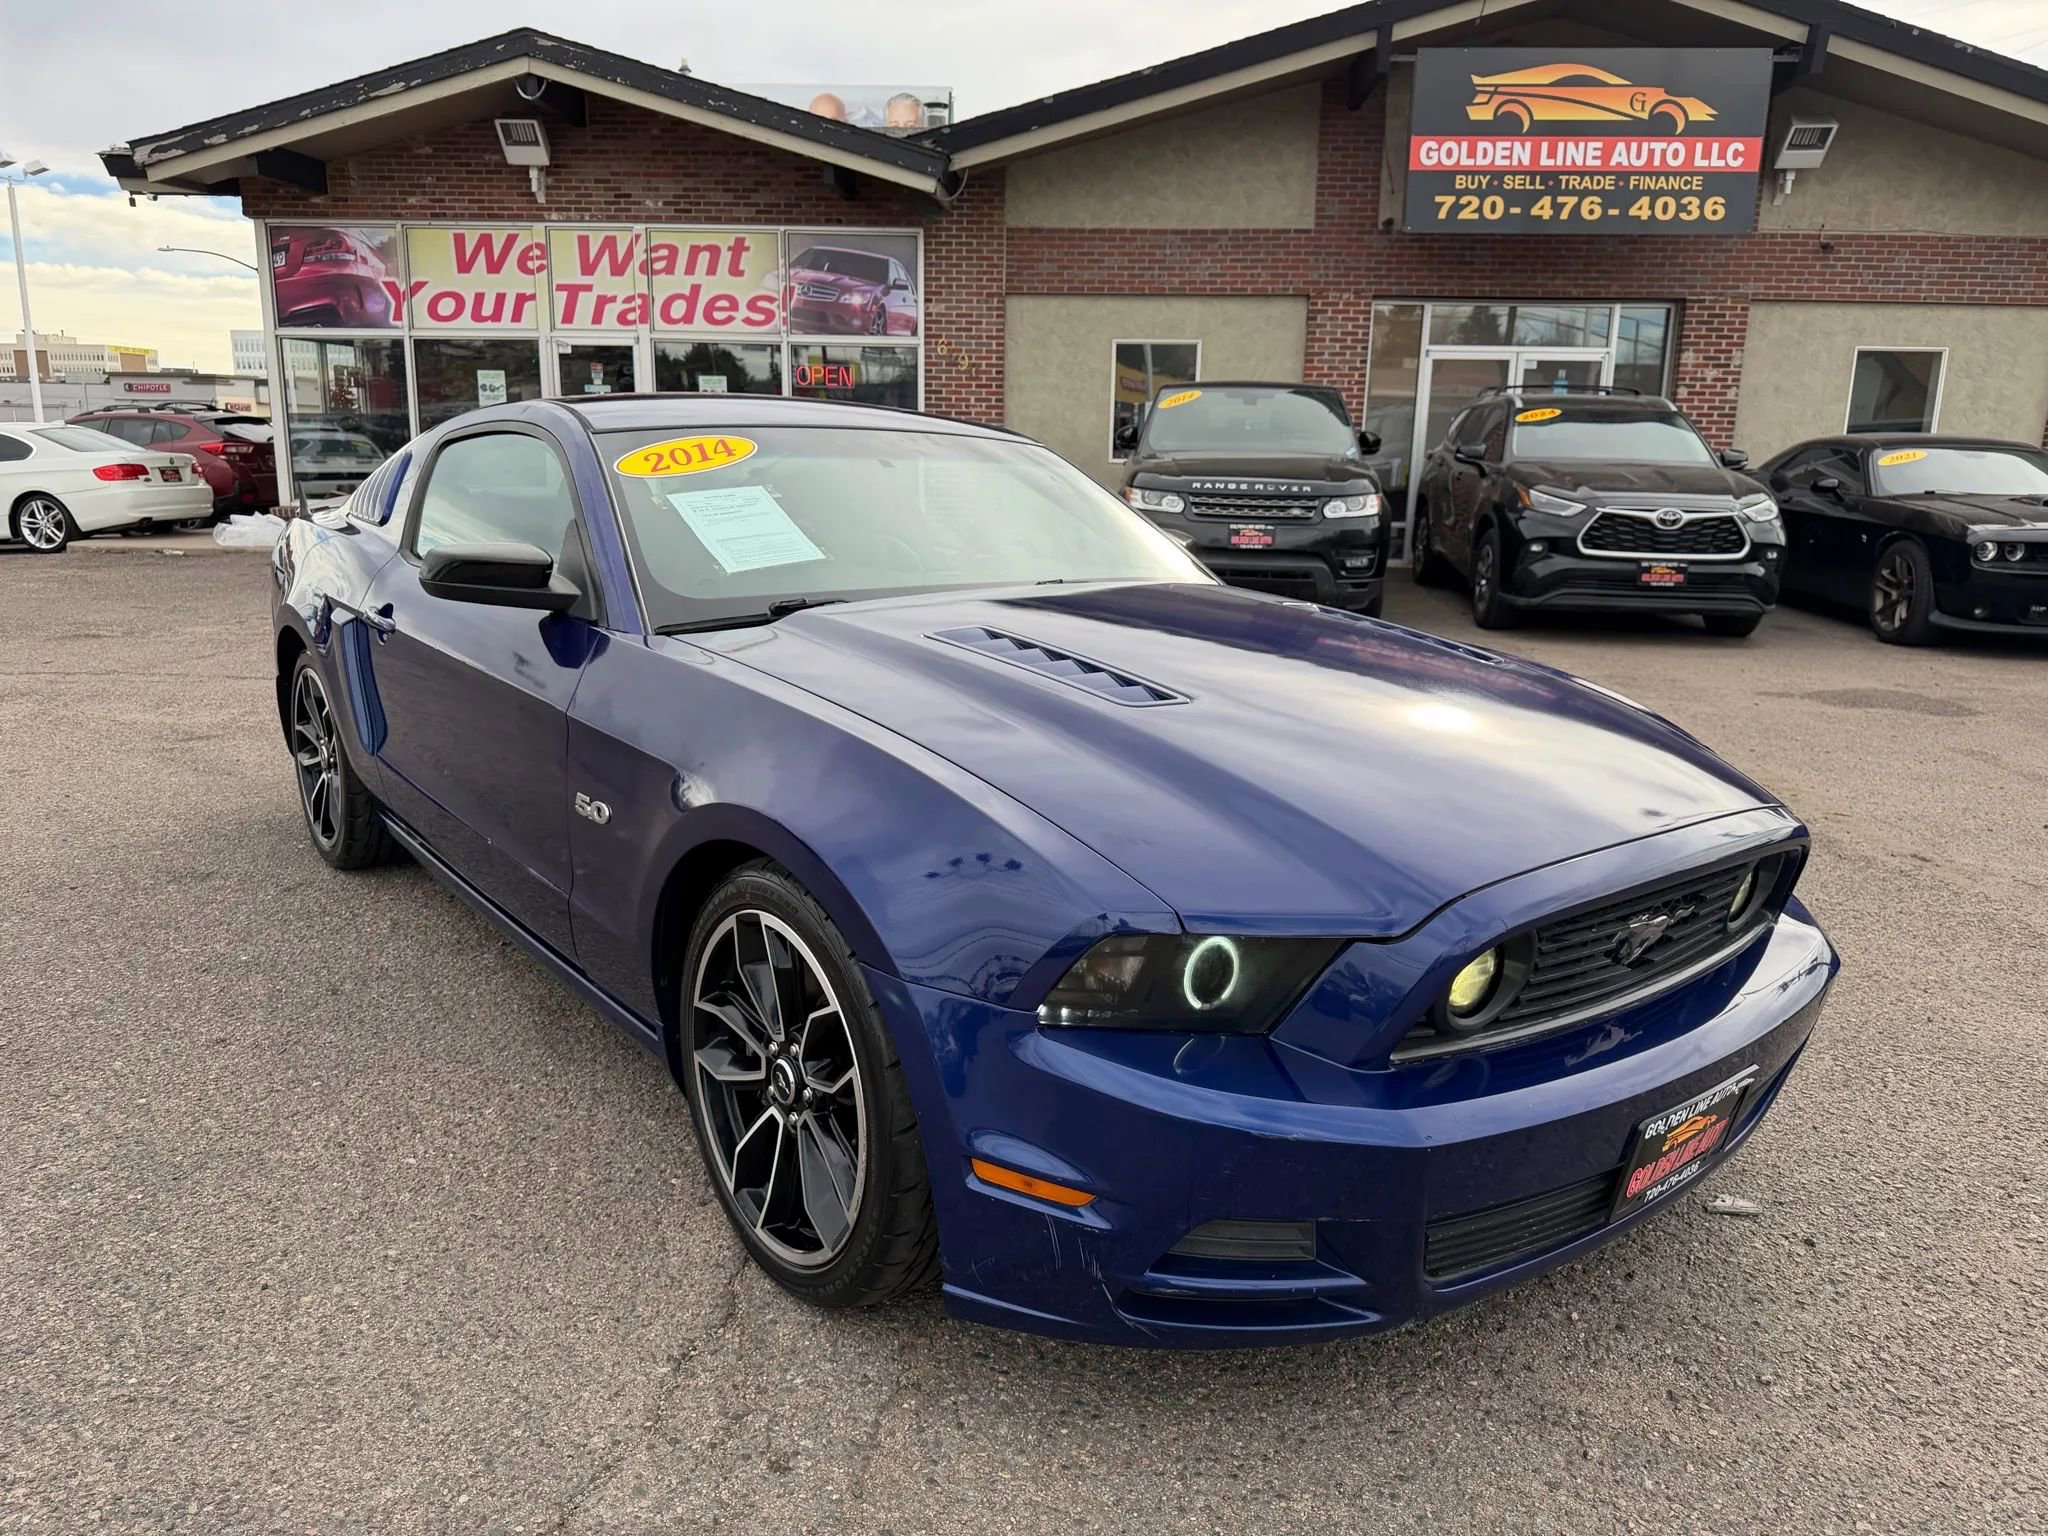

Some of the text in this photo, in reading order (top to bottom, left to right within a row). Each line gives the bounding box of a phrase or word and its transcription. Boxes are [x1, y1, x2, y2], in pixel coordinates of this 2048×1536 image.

[1419, 141, 1745, 167] GOLDEN LINE AUTO LLC
[1455, 175, 1704, 190] BUY SELL TRADE FINANCE
[453, 232, 751, 278] We Want
[381, 280, 797, 328] Your Trades!
[132, 384, 169, 392] CHIPOTLE
[796, 365, 853, 388] OPEN
[643, 438, 737, 473] 2014
[1192, 482, 1311, 493] RANGE ROVER
[1644, 1107, 1690, 1140] GOLDEN
[1687, 1095, 1714, 1117] LINE
[1627, 1148, 1680, 1198] GOLDEN
[1643, 1161, 1701, 1203] 720-476-4036
